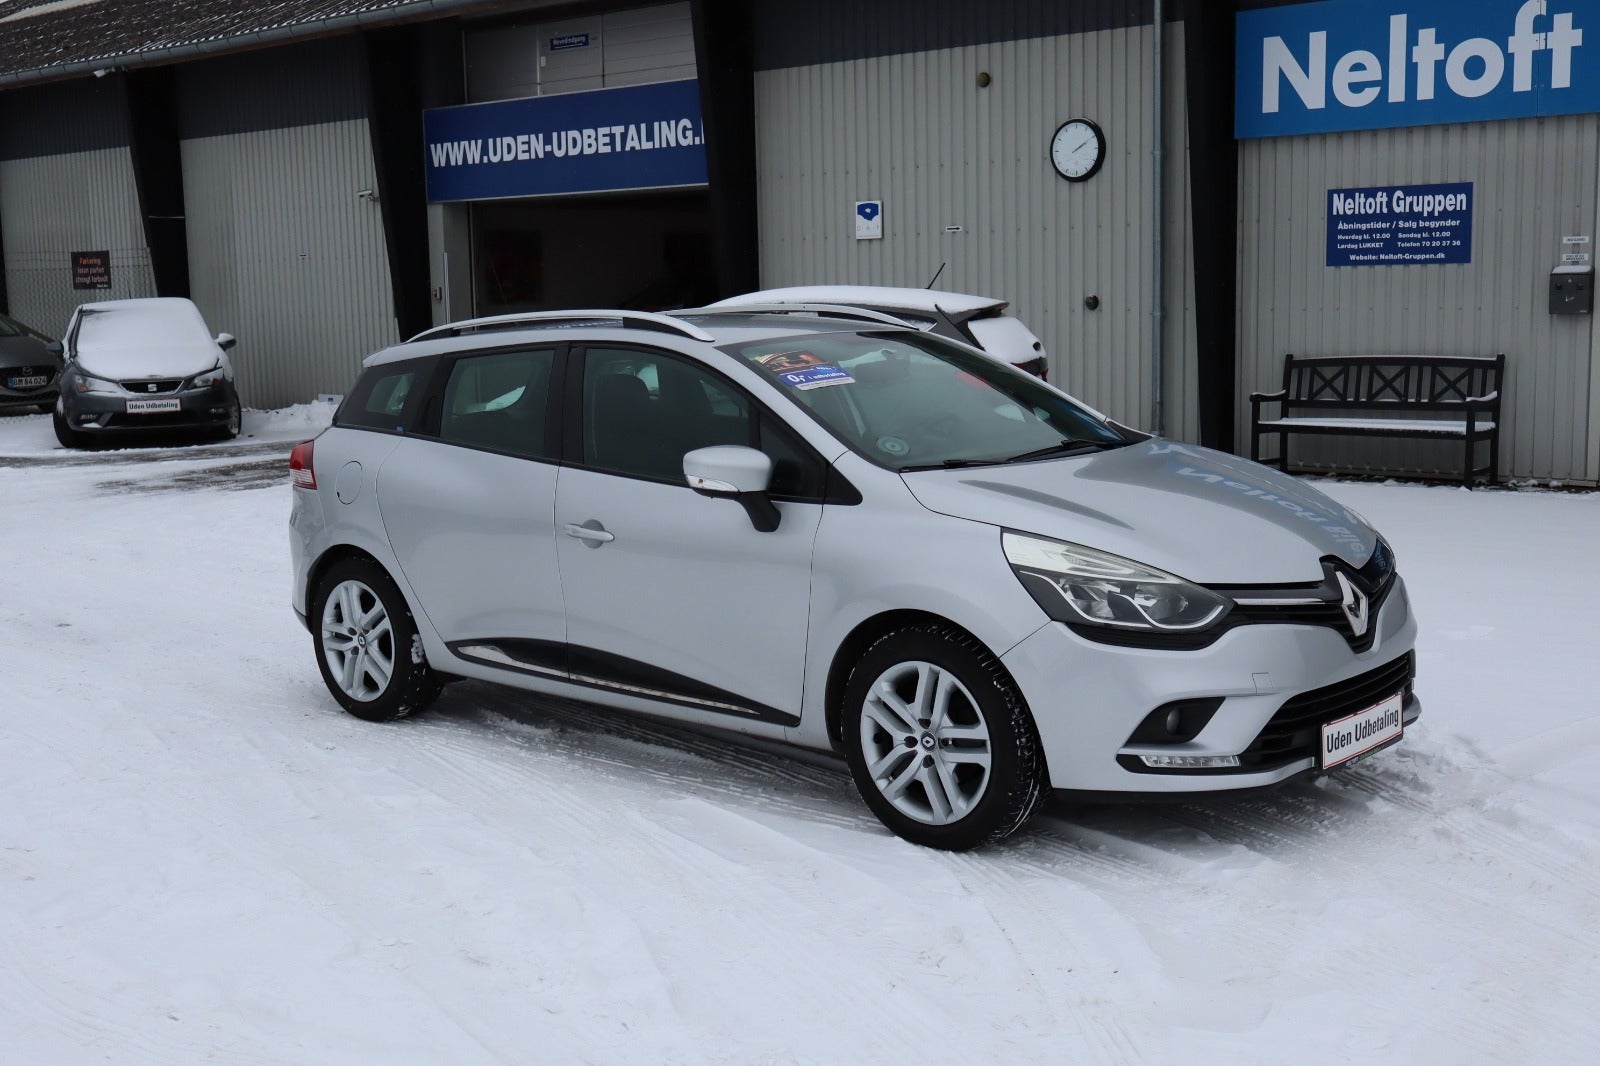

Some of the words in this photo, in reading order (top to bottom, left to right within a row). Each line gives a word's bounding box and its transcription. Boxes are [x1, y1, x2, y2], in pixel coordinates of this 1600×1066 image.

[1262, 0, 1583, 114] Neltoft
[430, 118, 704, 167] WWW.UDEN-UDBETALING.
[1332, 191, 1388, 216] Neltoft
[1392, 190, 1467, 217] Gruppen
[1337, 220, 1391, 231] Åbningstider
[1398, 220, 1417, 229] Salg
[1419, 219, 1461, 229] begynder
[1337, 233, 1362, 241] Hverdag
[1380, 252, 1446, 261] Neltoft-Gruppen.dk
[1326, 731, 1352, 754] Uden
[1355, 708, 1399, 742] Udbetaling
